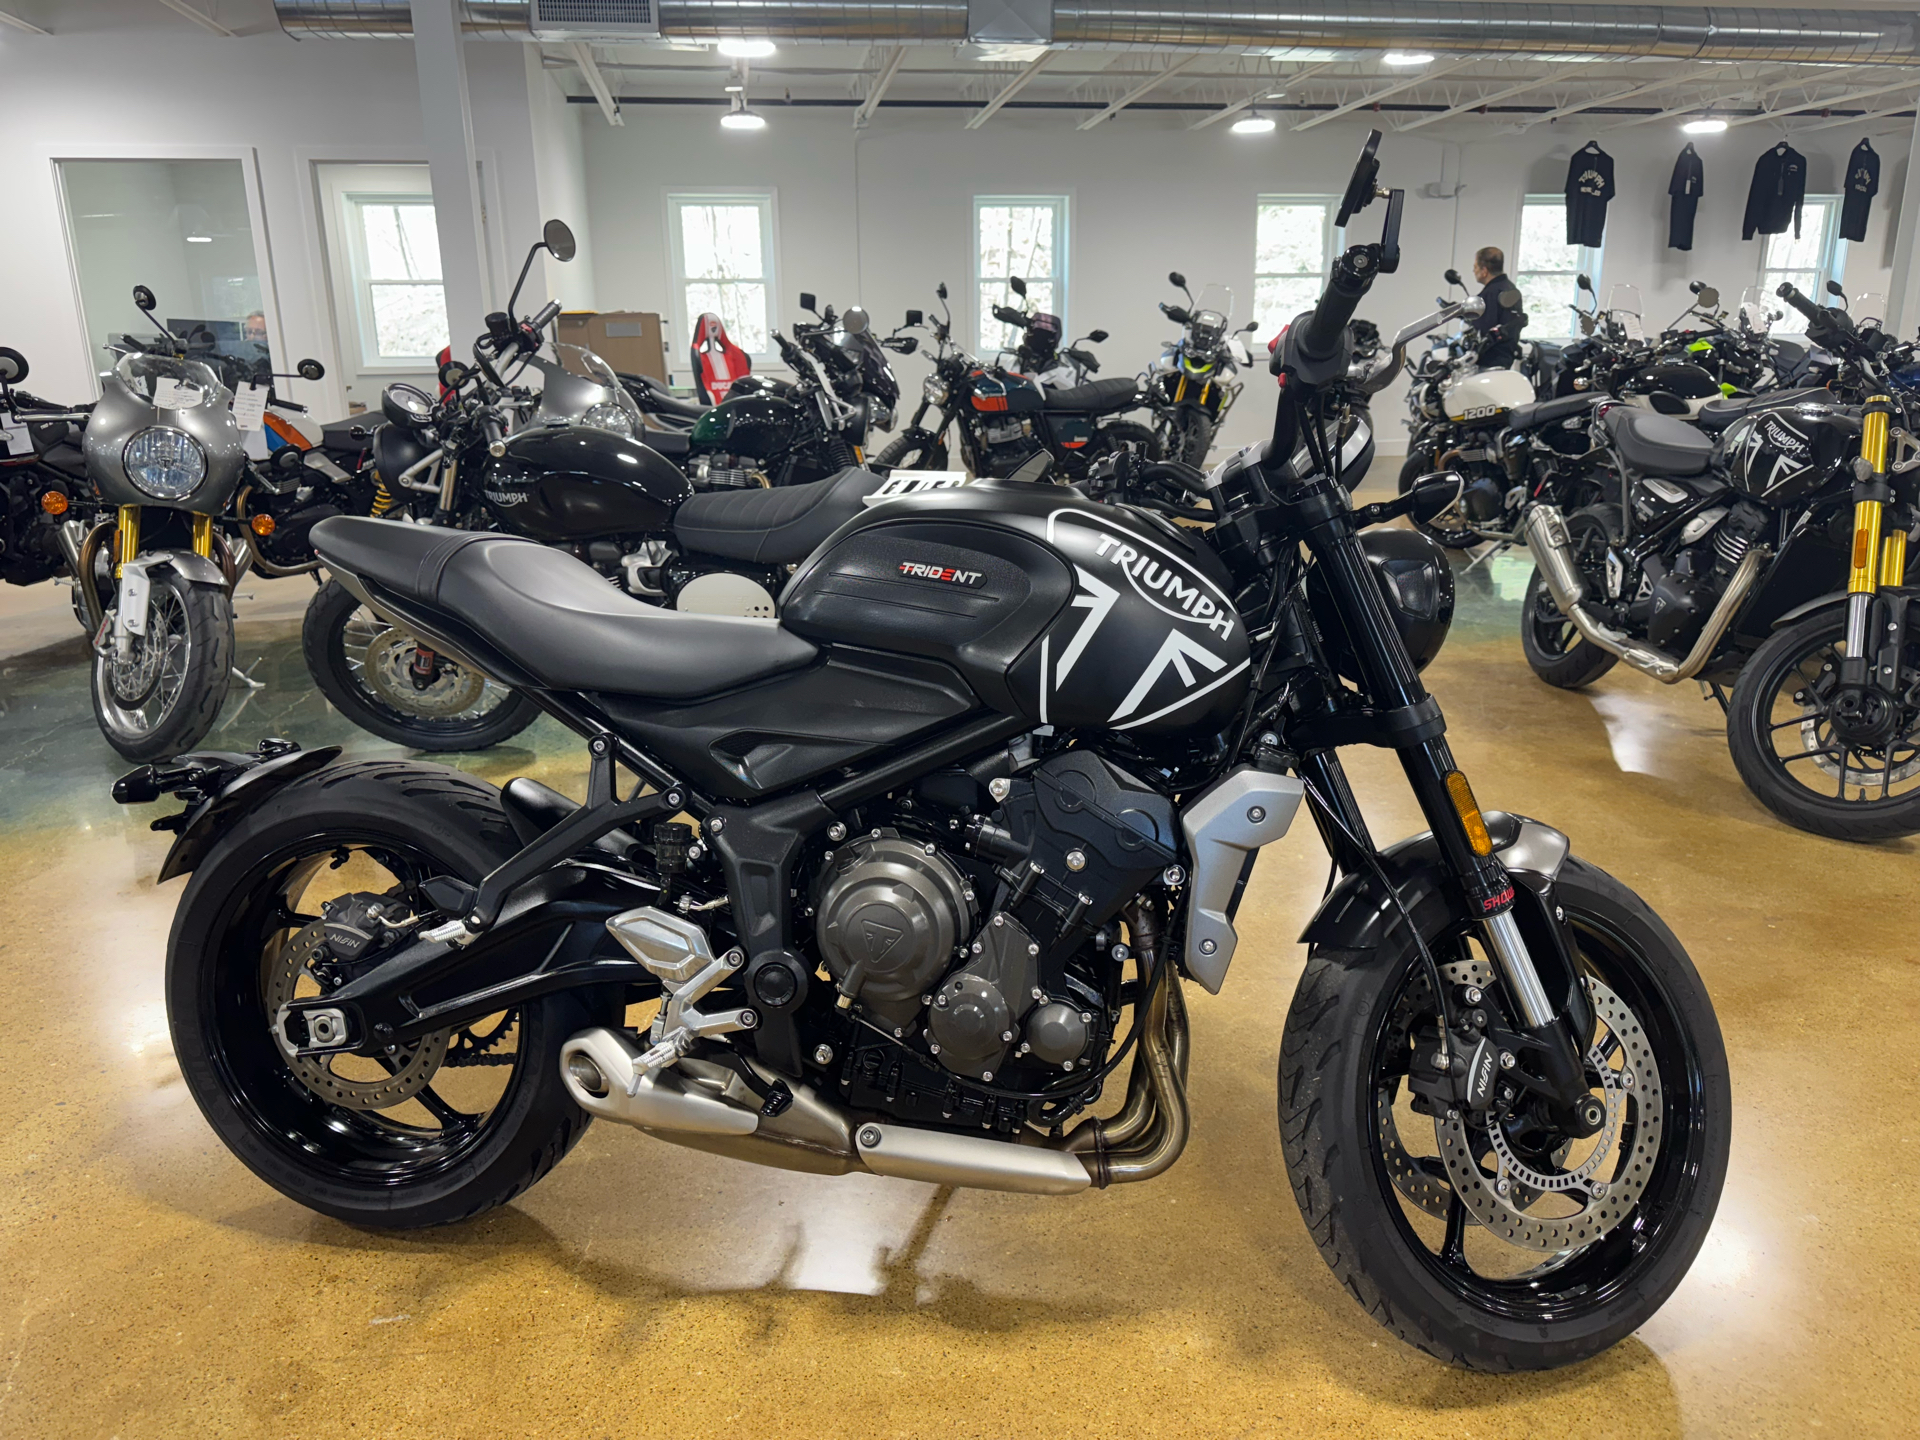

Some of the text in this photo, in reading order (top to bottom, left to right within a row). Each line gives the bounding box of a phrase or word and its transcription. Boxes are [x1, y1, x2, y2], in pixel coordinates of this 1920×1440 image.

[711, 381, 732, 391] DUCA
[1463, 404, 1496, 421] 1200
[1764, 420, 1805, 453] TRIUMPH
[483, 489, 528, 506] TRIUMPH
[899, 561, 982, 585] TRIDENT
[1095, 533, 1235, 642] TRIUMPH
[1483, 885, 1515, 911] SHOW
[329, 933, 360, 949] NISSIN
[1476, 1051, 1493, 1098] NISSIN
